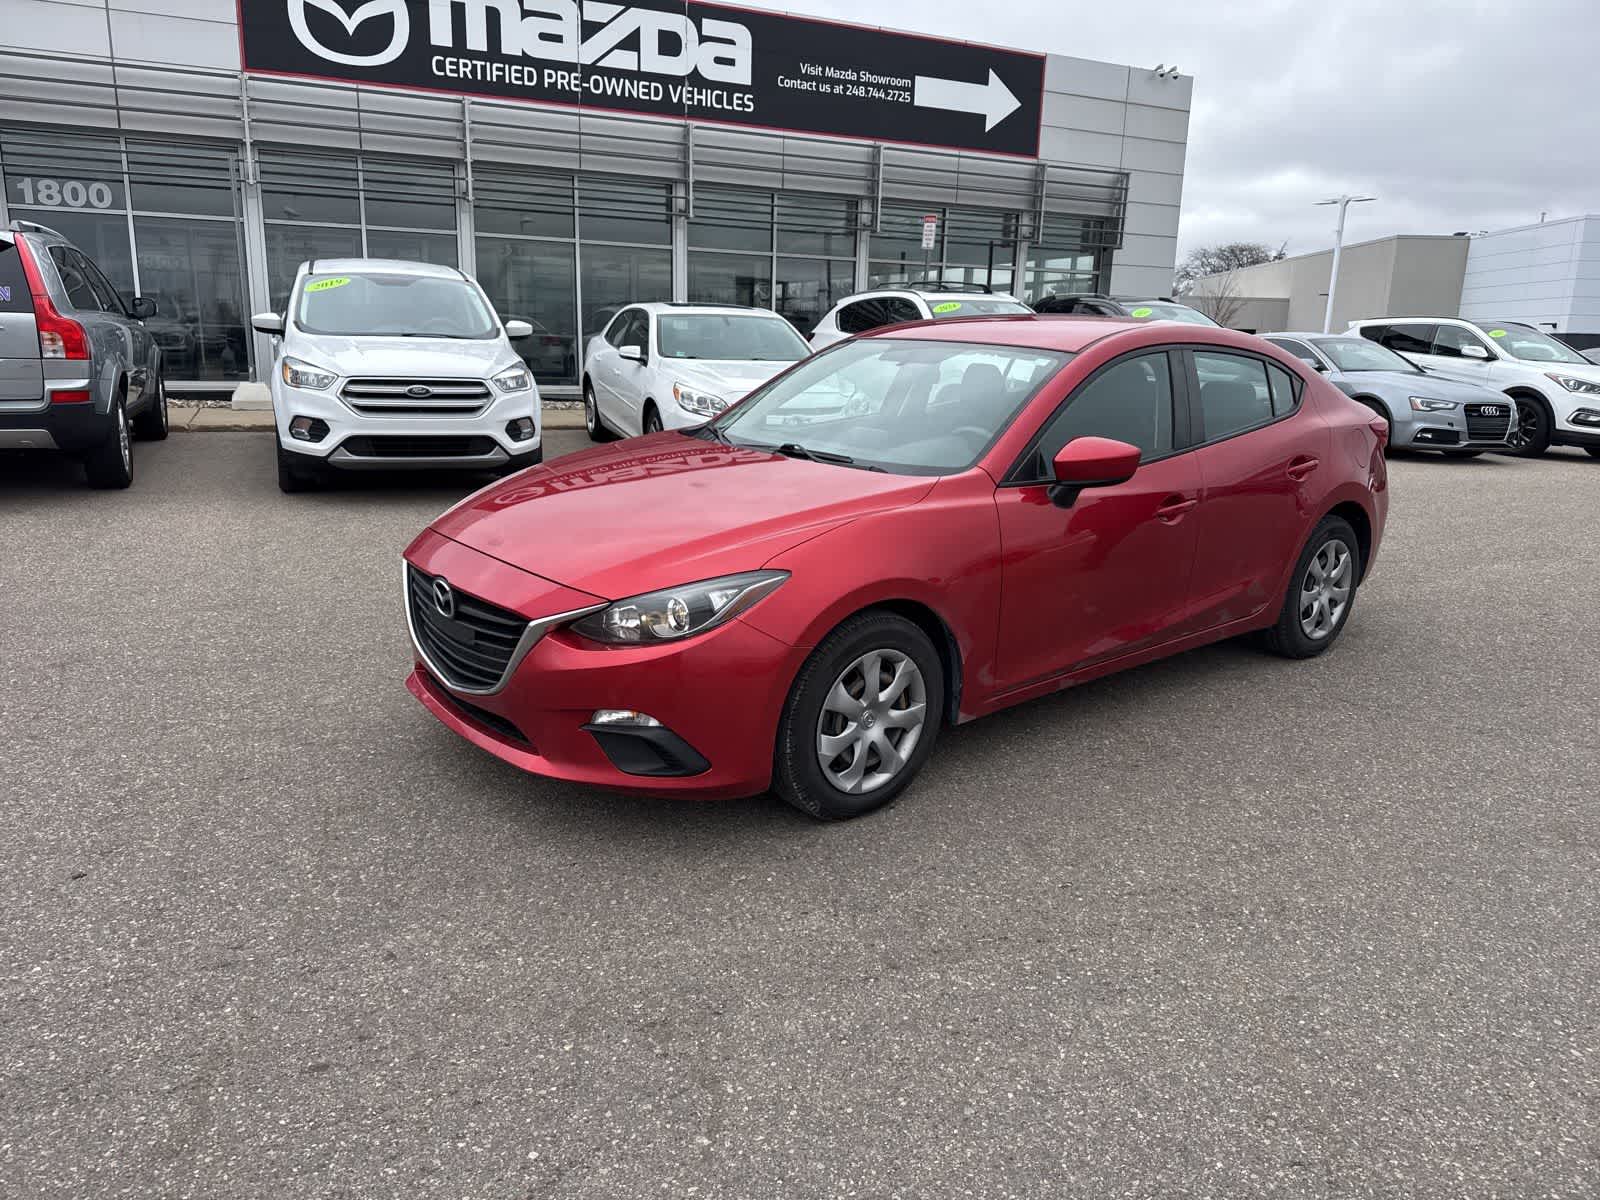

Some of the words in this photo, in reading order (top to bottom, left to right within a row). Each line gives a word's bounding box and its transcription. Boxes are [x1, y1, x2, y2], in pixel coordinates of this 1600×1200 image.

[431, 55, 537, 87] CERTIFIED
[544, 69, 662, 101] PRE-OWNED
[668, 84, 754, 113] VEHICLES
[777, 75, 816, 91] Contact
[819, 82, 831, 93] us
[833, 84, 844, 94] at
[846, 84, 911, 103] 248.744.2725
[799, 62, 822, 77] Visit
[825, 66, 857, 81] Mazda
[859, 71, 912, 88] Showroom
[17, 177, 113, 209] 1800
